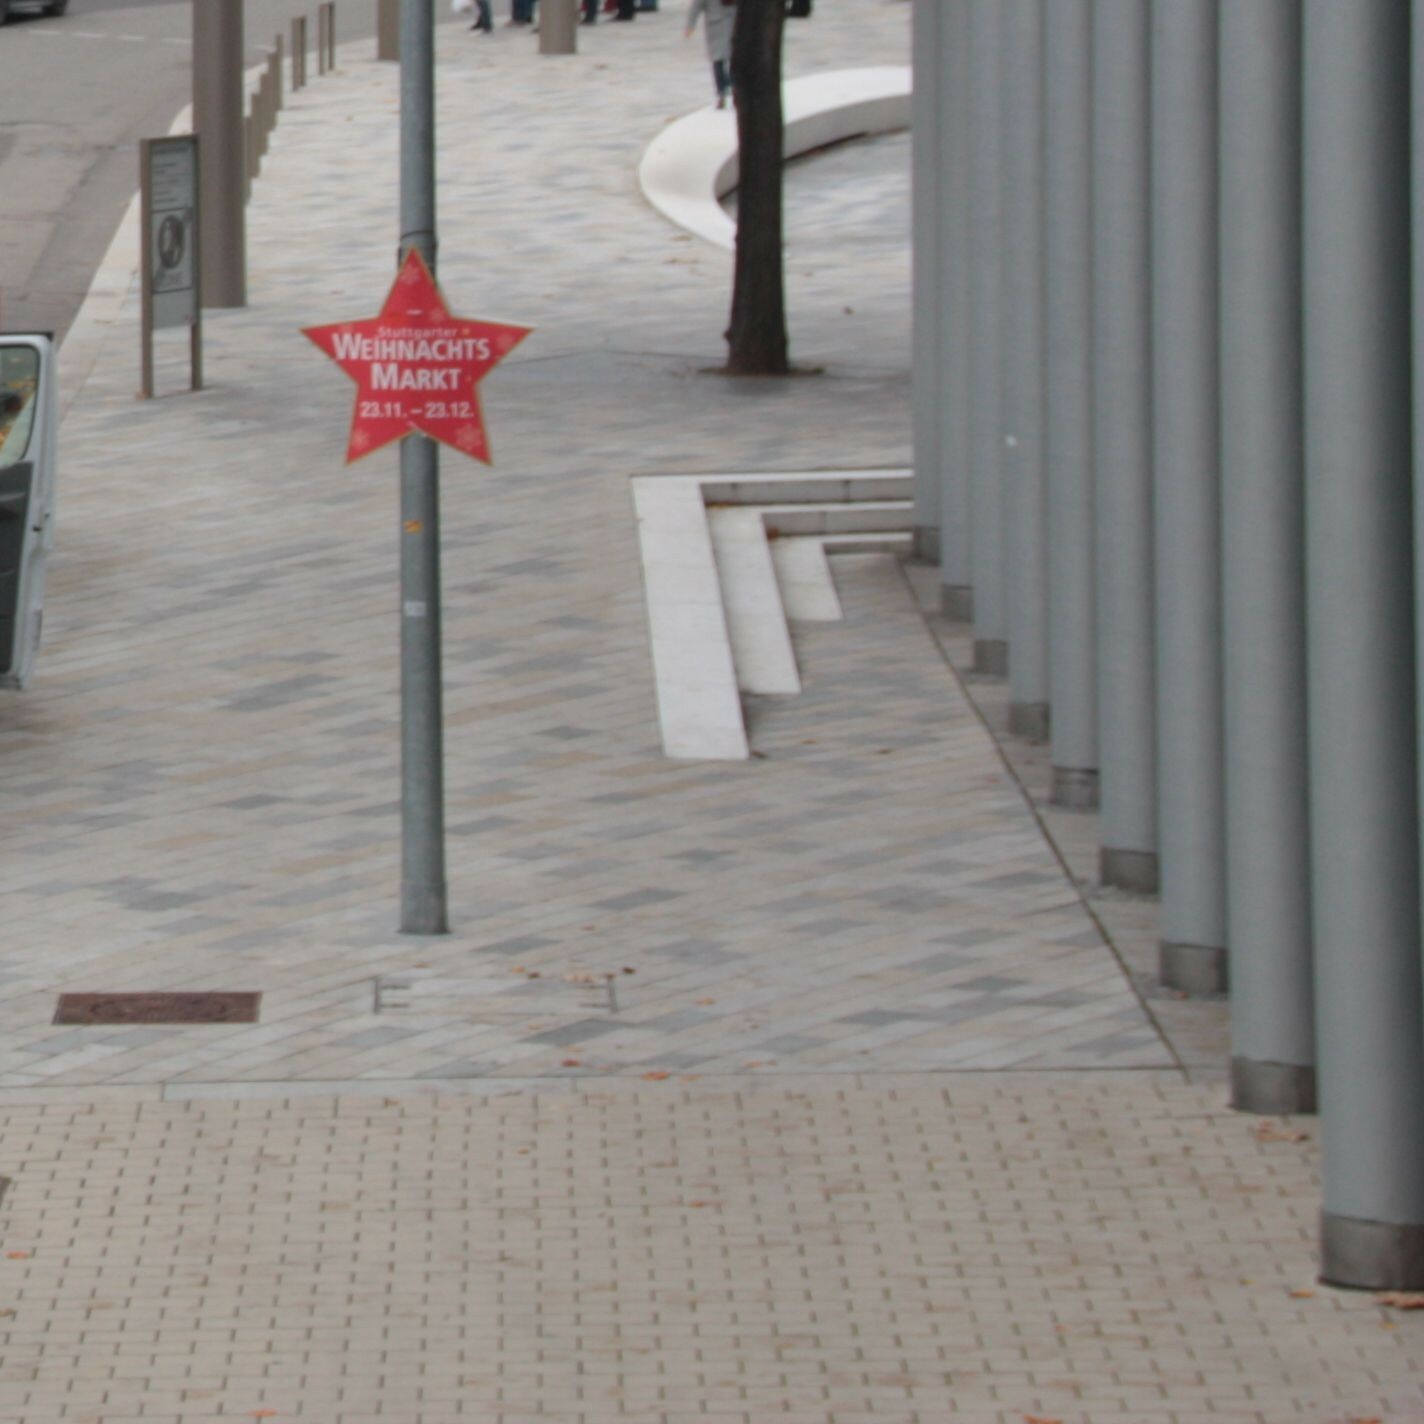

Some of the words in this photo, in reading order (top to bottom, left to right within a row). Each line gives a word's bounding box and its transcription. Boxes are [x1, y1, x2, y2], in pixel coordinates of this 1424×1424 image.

[377, 327, 458, 340] Stuttgarter
[331, 333, 490, 361] WEIHNACHTS
[370, 362, 461, 390] MARKT
[360, 401, 407, 418] 23.11.
[425, 401, 474, 419] 23.12.
